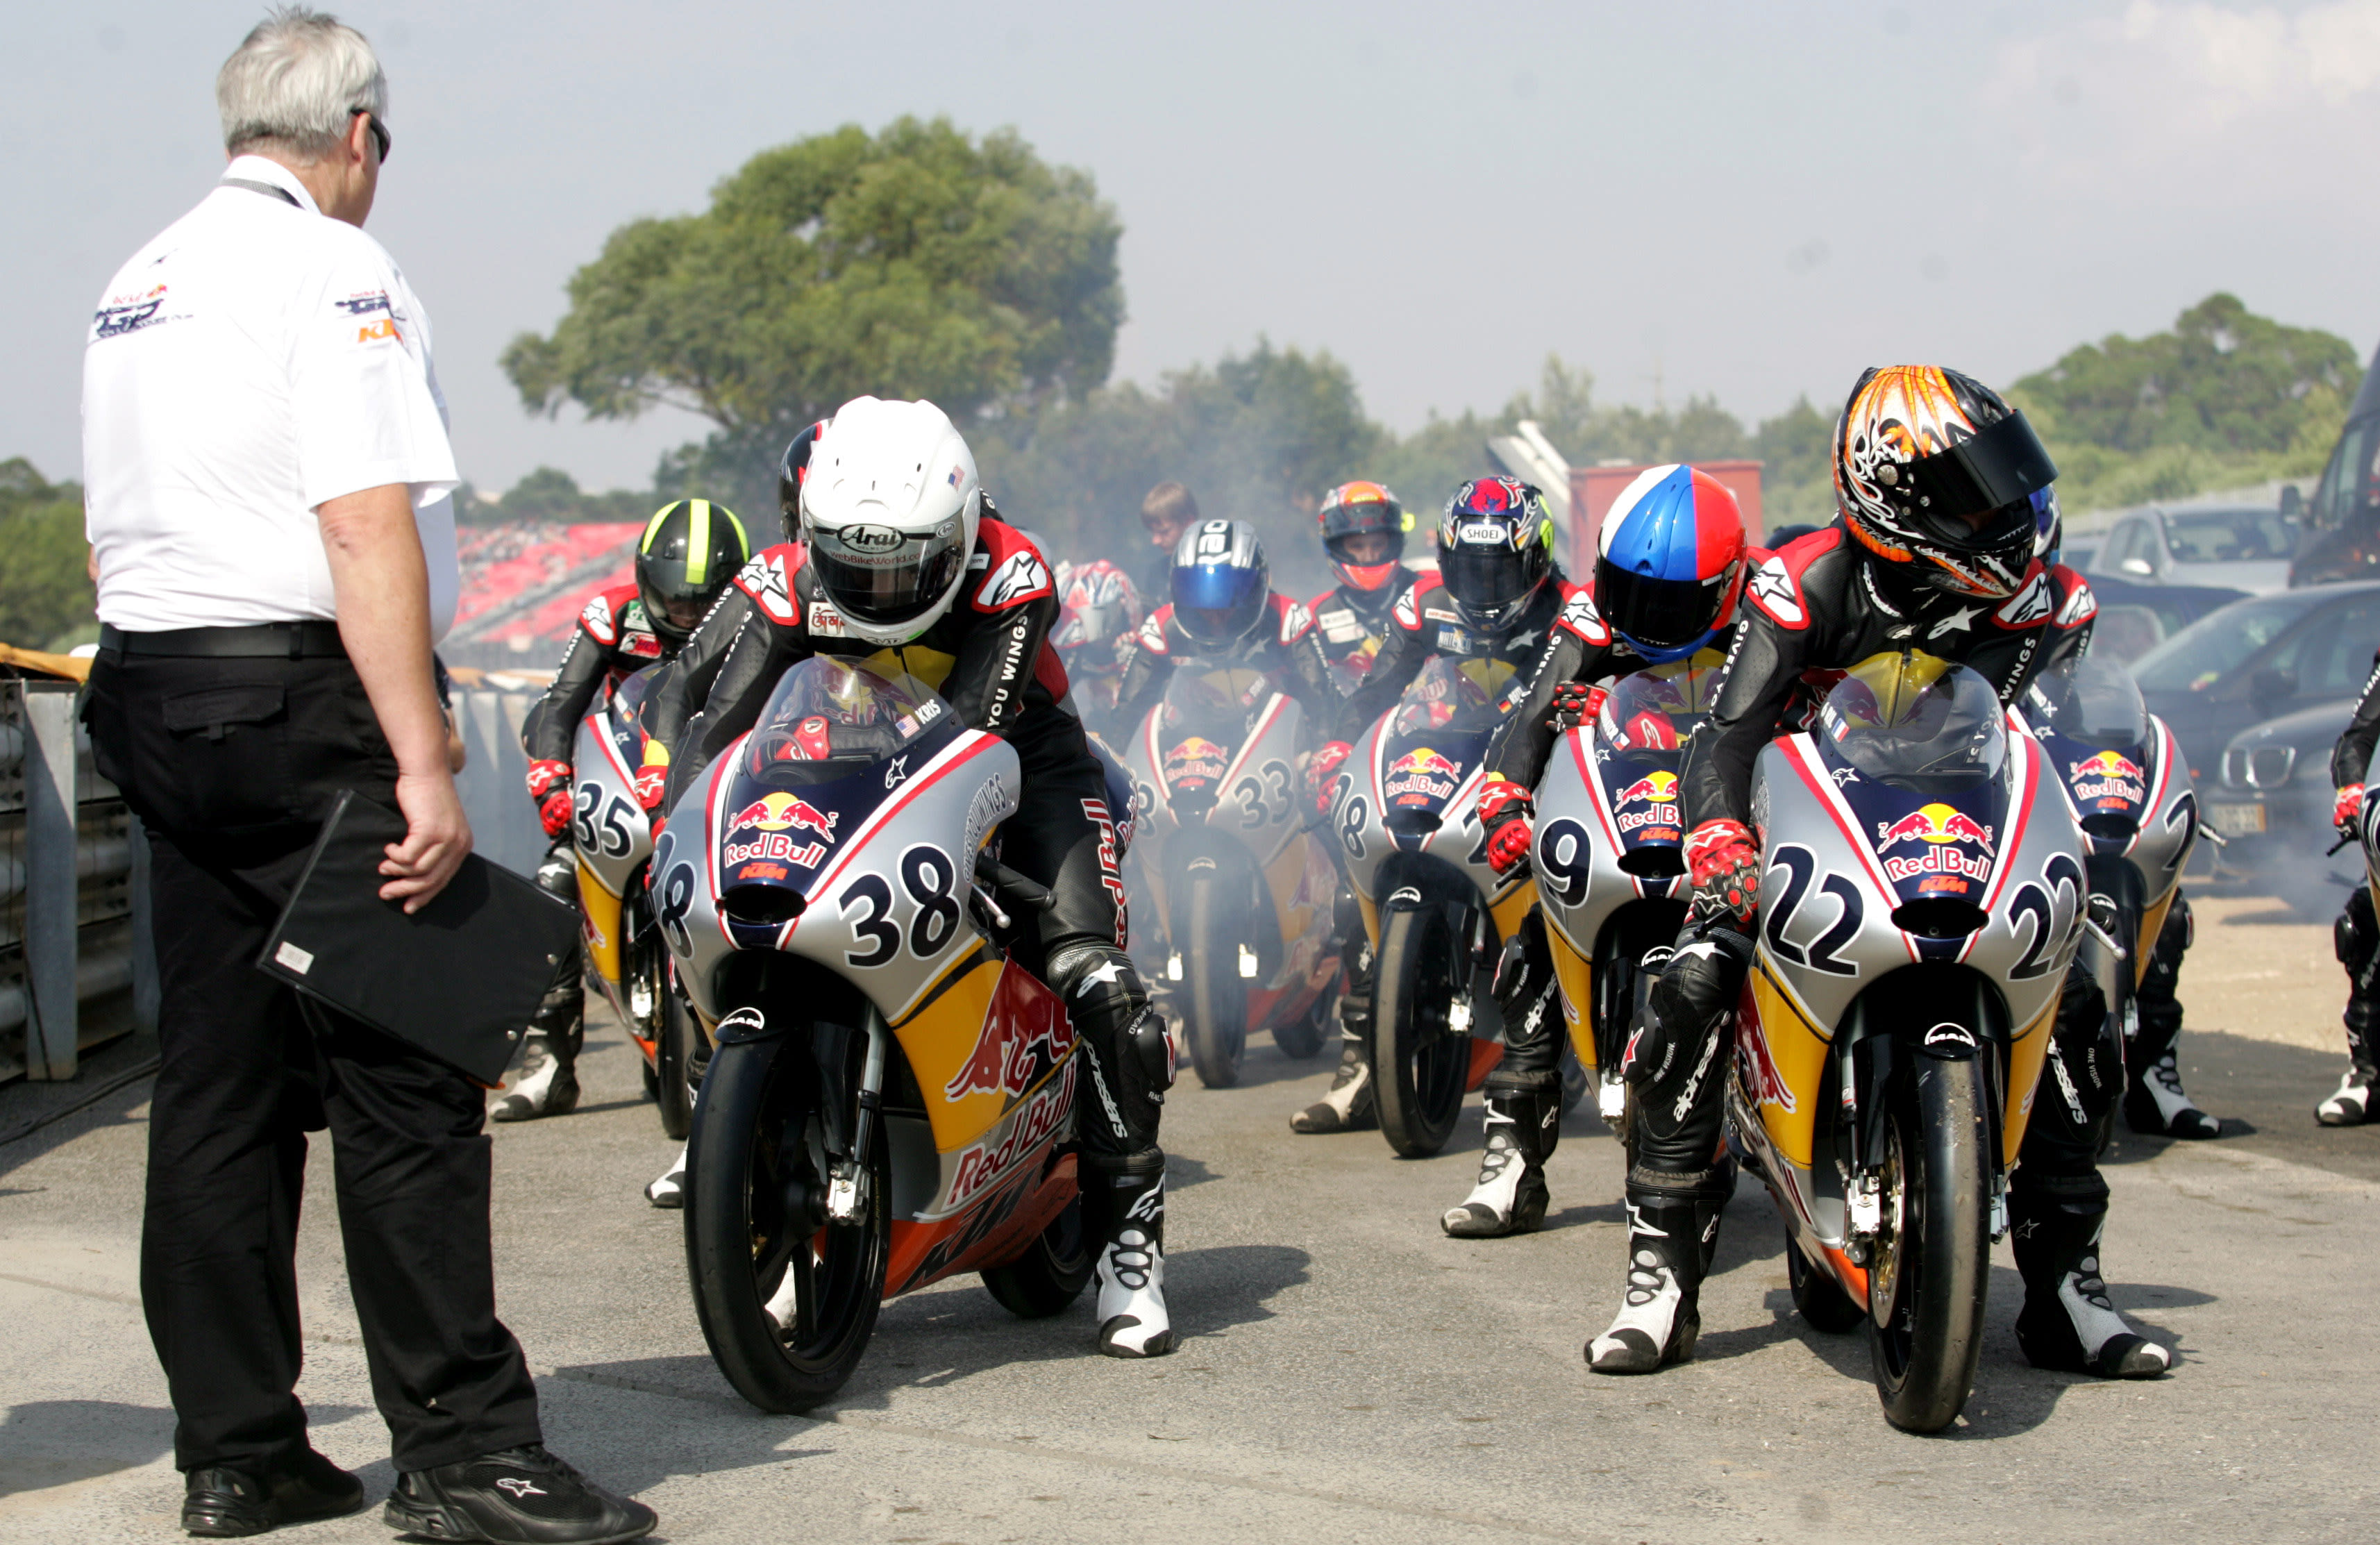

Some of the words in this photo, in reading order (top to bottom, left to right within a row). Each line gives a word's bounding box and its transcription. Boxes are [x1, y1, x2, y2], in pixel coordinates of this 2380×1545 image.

[844, 526, 898, 546] Arai
[1467, 528, 1499, 539] SHOEI
[1722, 619, 1750, 675] GIVES
[987, 687, 1009, 728] YOU
[1000, 614, 1029, 681] WINGS
[1999, 637, 2036, 700] WINGS
[914, 699, 941, 725] KRIS
[1234, 758, 1296, 832] 33
[1386, 774, 1417, 799] Red
[1416, 775, 1455, 800] Bull
[2074, 776, 2113, 801] Red
[2112, 778, 2144, 805] Bull
[576, 779, 637, 860] 35
[1080, 797, 1121, 875] Bull
[1617, 802, 1660, 833] Red
[1639, 826, 1679, 842] KTM
[725, 833, 770, 869] Red
[769, 833, 827, 869] Bull
[1537, 815, 1594, 910] 9
[1883, 844, 1942, 883] Red
[1942, 846, 1992, 883] Bull
[738, 862, 788, 881] KTM
[1917, 875, 1969, 894] KTM
[837, 842, 962, 970] 38
[1763, 842, 1863, 978] 22
[2004, 851, 2086, 983] 22
[2087, 1047, 2095, 1064] ONE
[941, 1103, 1027, 1212] Red
[1012, 1051, 1078, 1163] Bull
